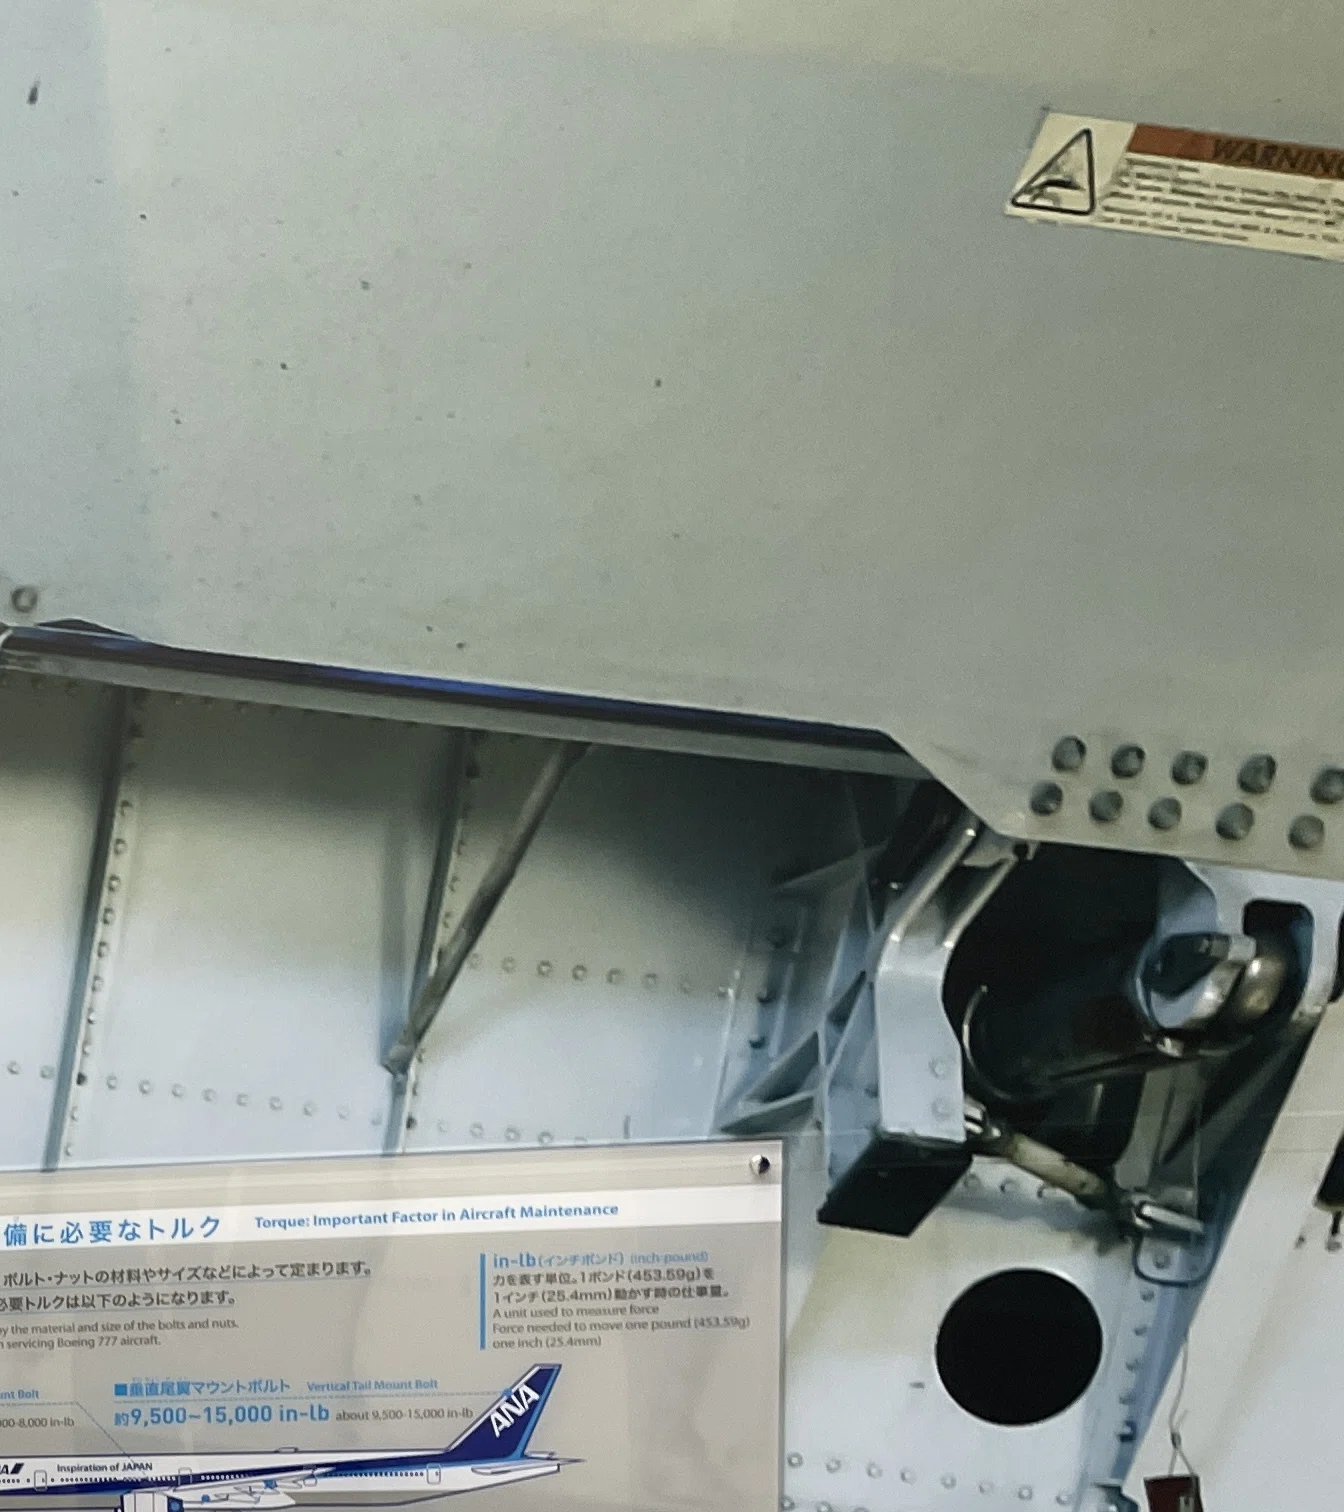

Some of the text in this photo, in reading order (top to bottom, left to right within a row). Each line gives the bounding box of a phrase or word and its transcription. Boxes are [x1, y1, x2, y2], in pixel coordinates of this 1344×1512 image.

[255, 1203, 619, 1232] Torque: Important Factor in Aircraft Maintenance
[11, 1324, 29, 1335] the
[30, 1323, 76, 1335] material
[77, 1322, 98, 1333] and
[100, 1321, 121, 1333] size
[123, 1321, 136, 1332] of
[137, 1320, 155, 1332] the
[158, 1320, 186, 1331] bolts
[188, 1319, 209, 1330] and
[211, 1318, 239, 1330] nuts.
[6, 1338, 55, 1352] servicing
[57, 1337, 95, 1351] Boeing
[97, 1336, 118, 1347] 777
[120, 1335, 162, 1347] aircraft.
[307, 1379, 438, 1392] Vertical Tail Mount Bolt
[17, 1389, 39, 1400] Bolt
[279, 1404, 329, 1421] in-lb
[336, 1409, 370, 1421] about
[447, 1407, 473, 1419] in-lb
[489, 1383, 540, 1439] ANA
[50, 1417, 74, 1428] in-lb
[56, 1463, 153, 1474] Inspiration of JAPAN
